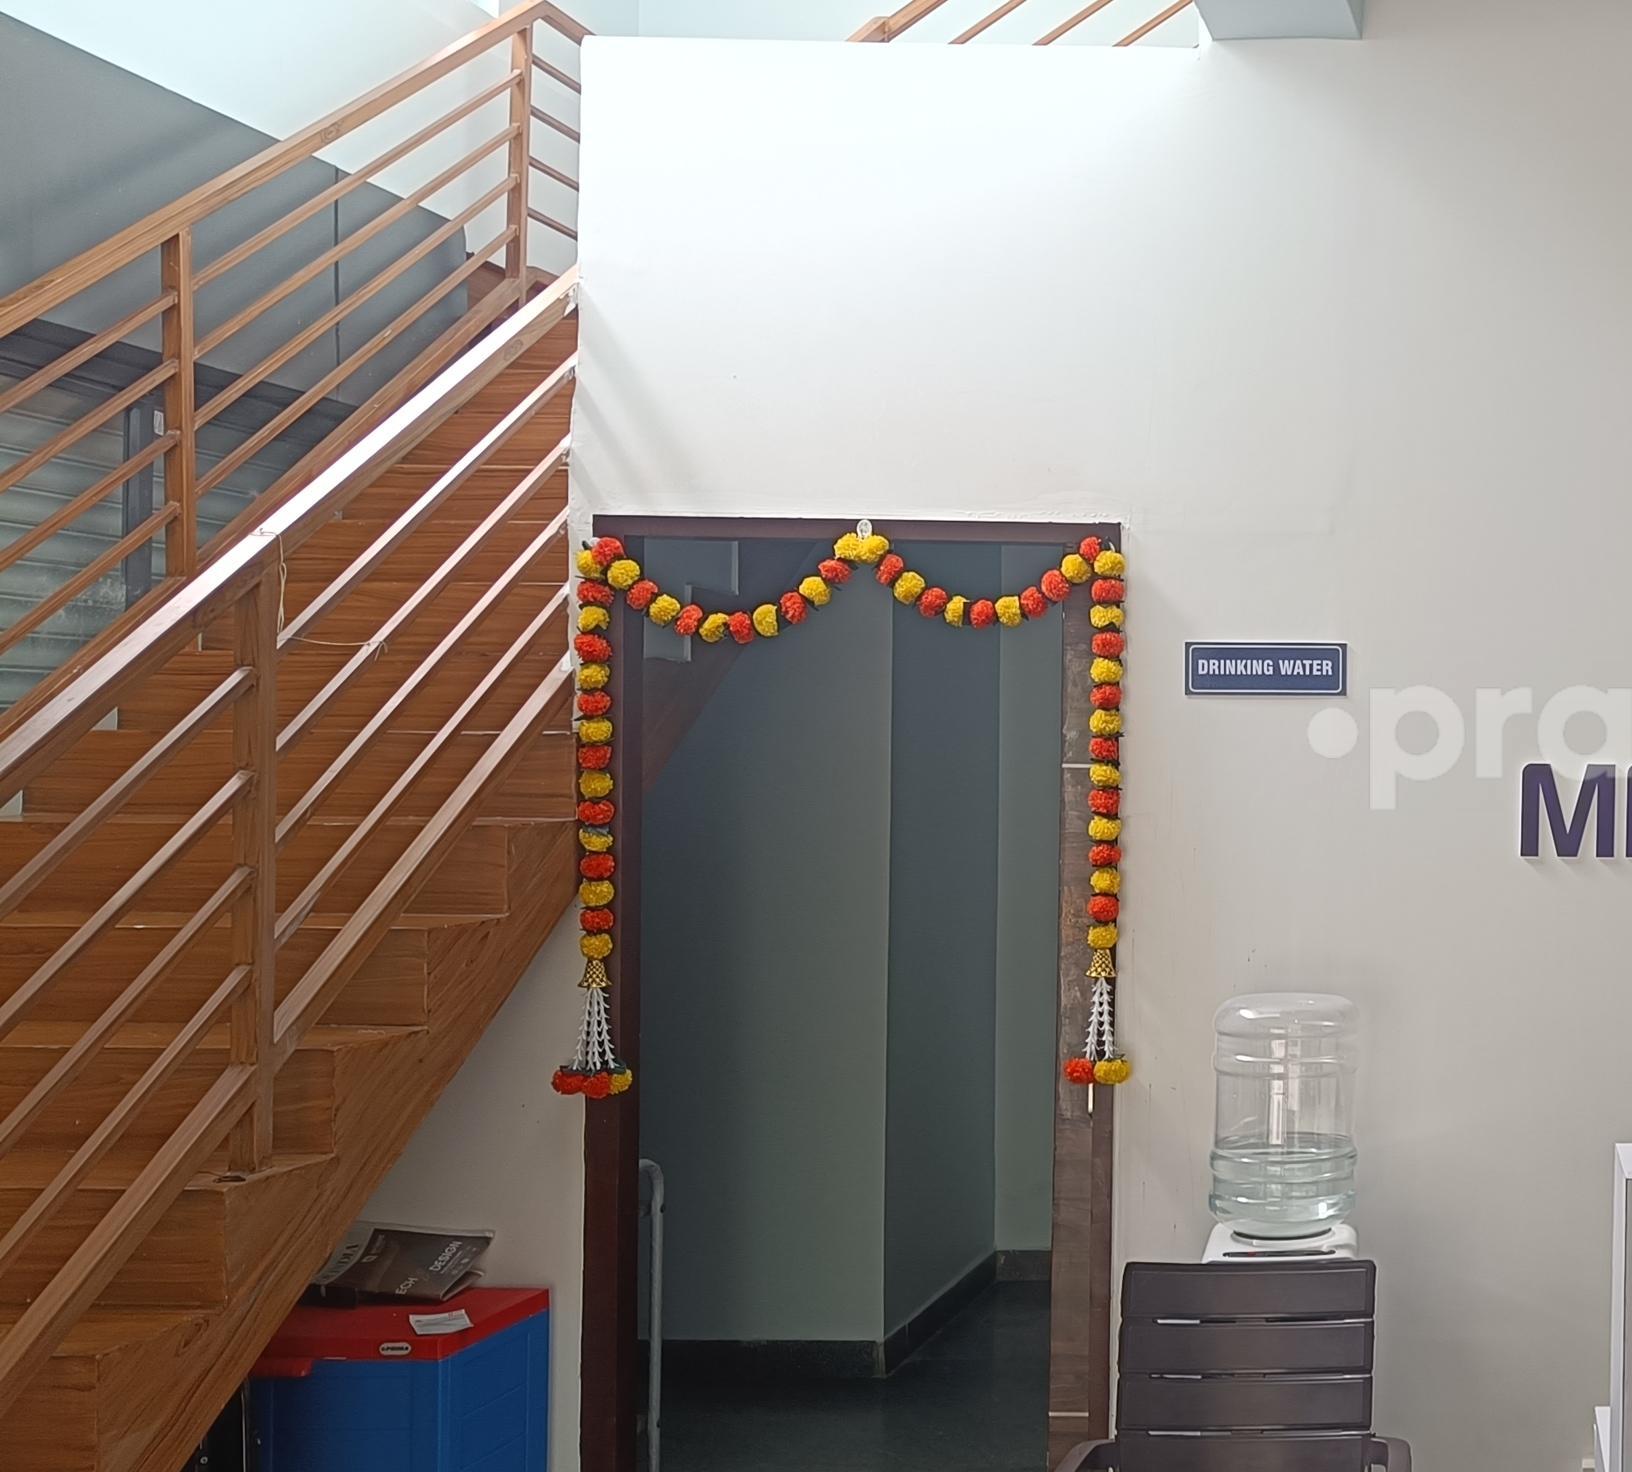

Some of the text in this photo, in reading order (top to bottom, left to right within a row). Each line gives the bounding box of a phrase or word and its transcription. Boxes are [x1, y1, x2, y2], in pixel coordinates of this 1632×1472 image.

[1198, 659, 1333, 676] DRINKING WATER
[428, 1240, 463, 1272] DESIGN
[395, 1276, 419, 1296] ECH
